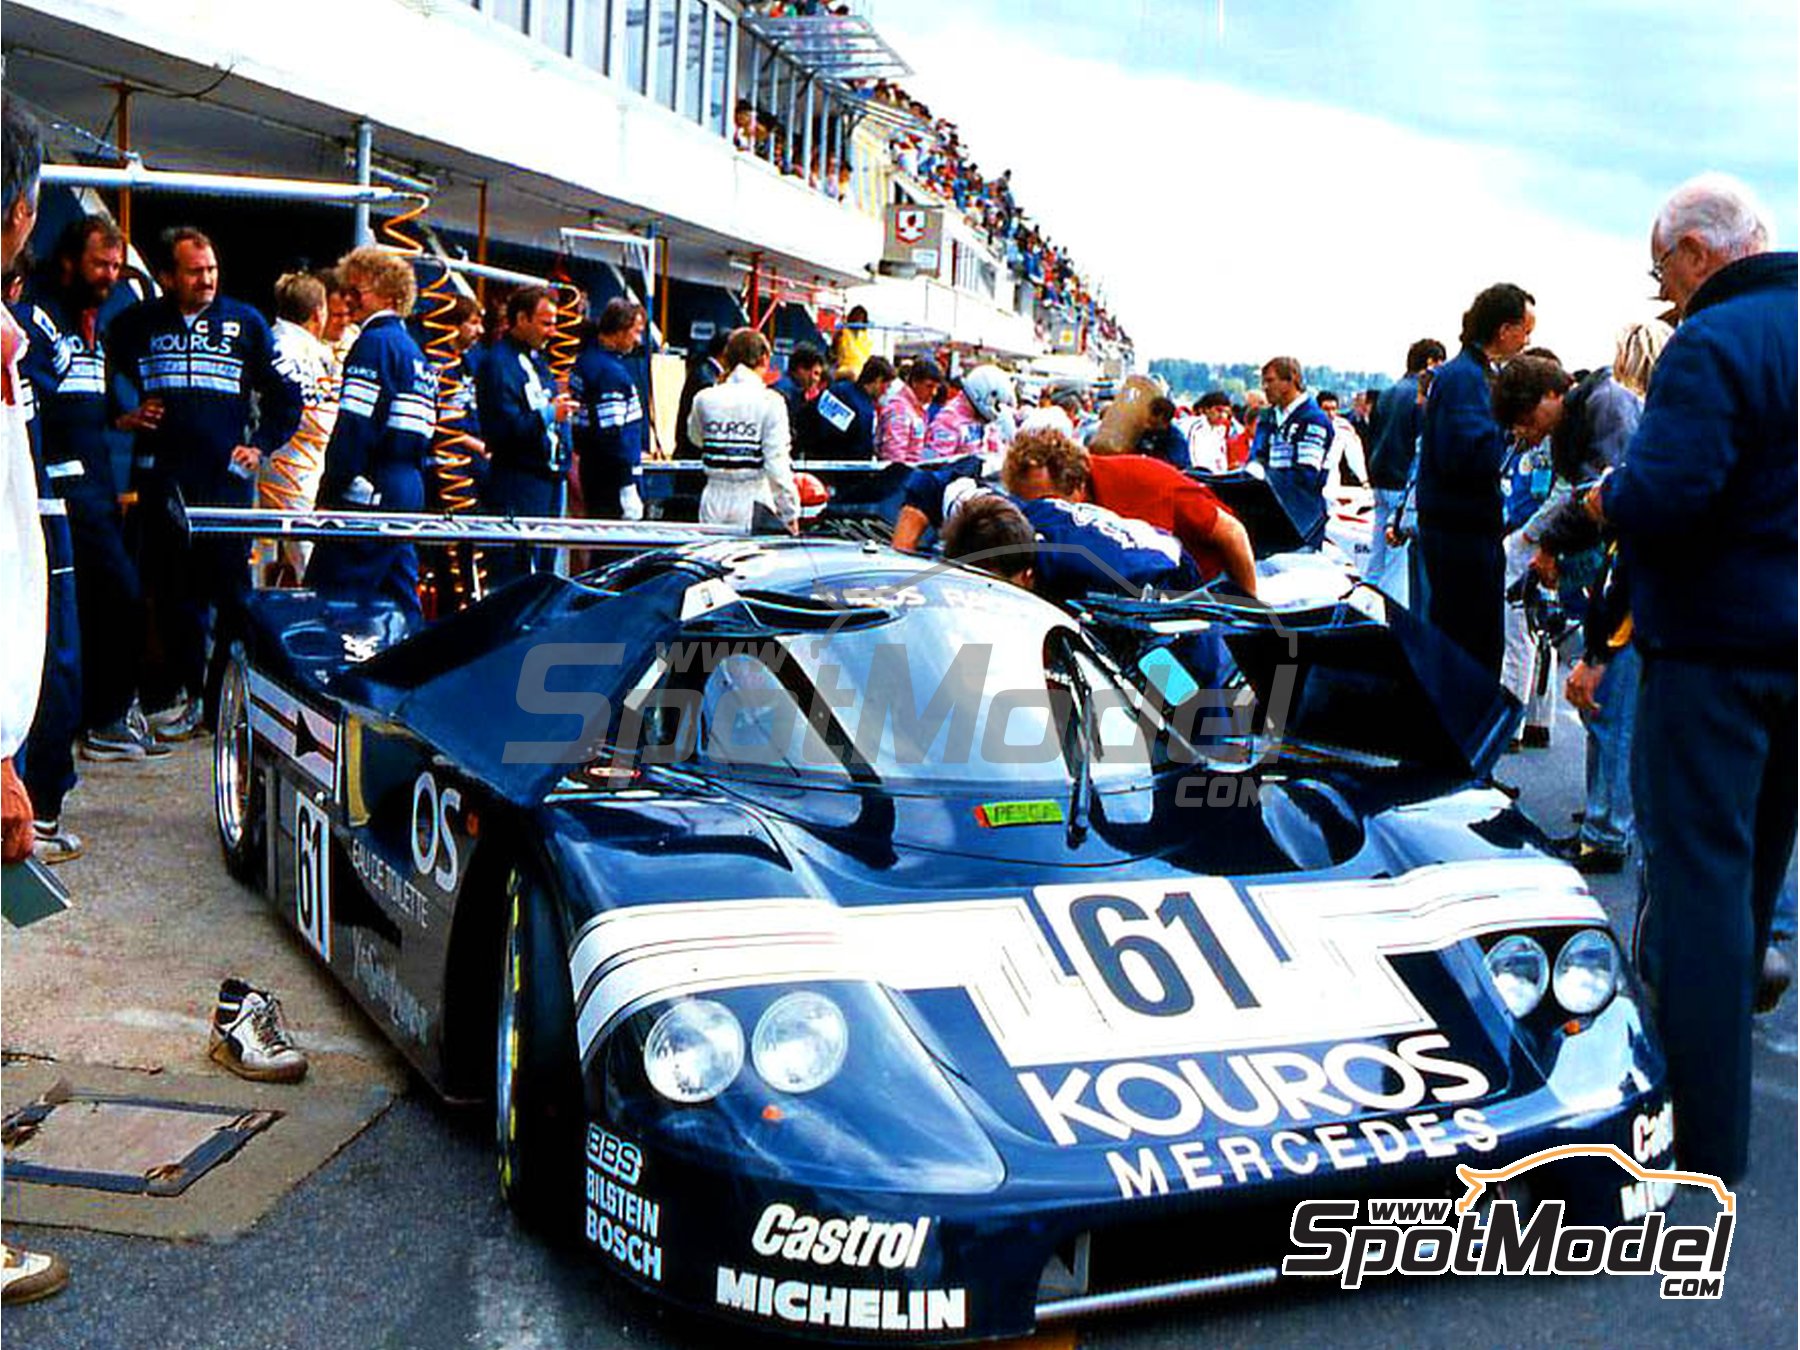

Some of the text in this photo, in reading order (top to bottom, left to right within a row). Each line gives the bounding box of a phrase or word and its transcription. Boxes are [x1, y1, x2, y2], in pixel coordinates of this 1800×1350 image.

[1069, 892, 1261, 1017] 61
[1017, 1034, 1489, 1146] KOUROS
[586, 1123, 644, 1185] BBS
[1106, 1108, 1501, 1198] MERCEDES
[586, 1166, 660, 1237] BILSTEIN
[751, 1203, 931, 1269] Castrol
[586, 1206, 662, 1281] BOSCH
[716, 1267, 966, 1330] MICHELIN
